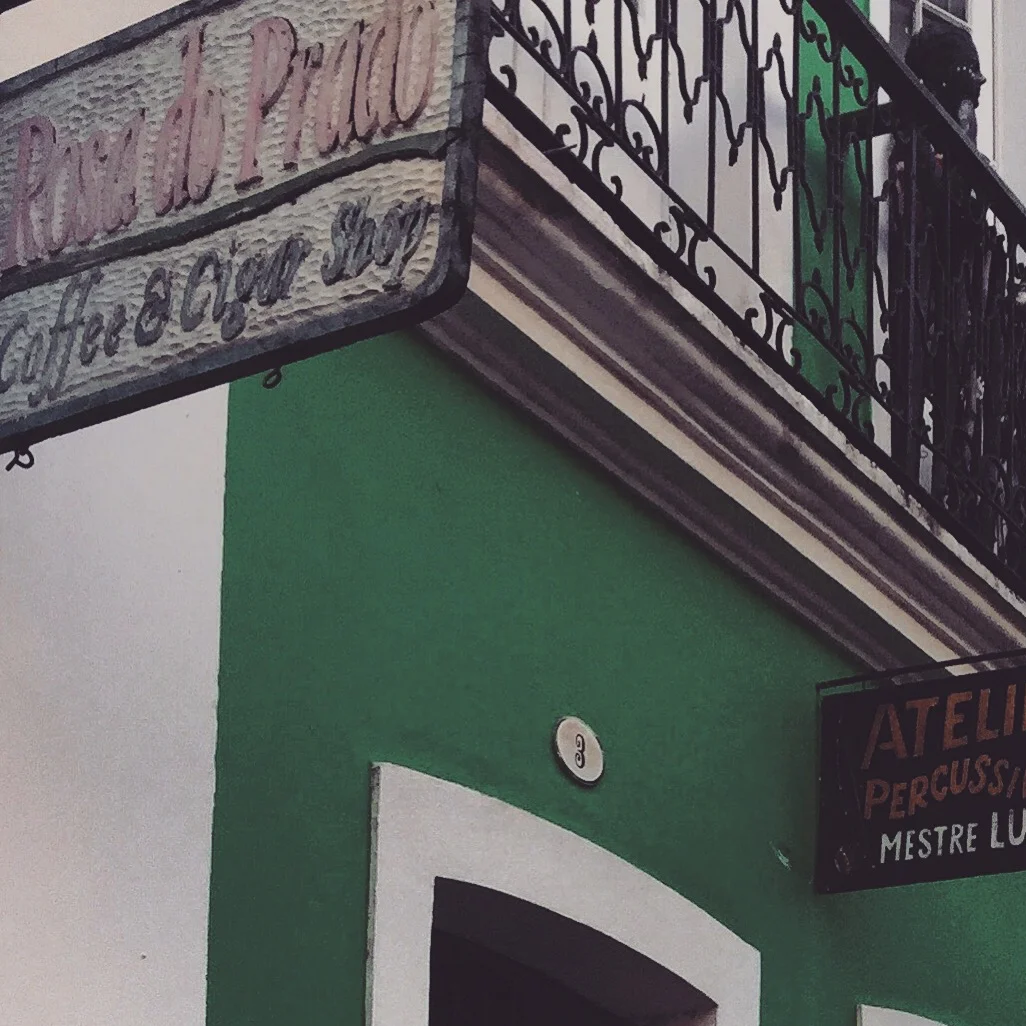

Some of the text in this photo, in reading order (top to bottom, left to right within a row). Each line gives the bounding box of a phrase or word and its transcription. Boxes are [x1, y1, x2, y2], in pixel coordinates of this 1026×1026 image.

[0, 266, 127, 408] Coffee
[180, 238, 312, 342] Cigar
[574, 733, 586, 769] 3
[879, 822, 979, 864] MESTRE
